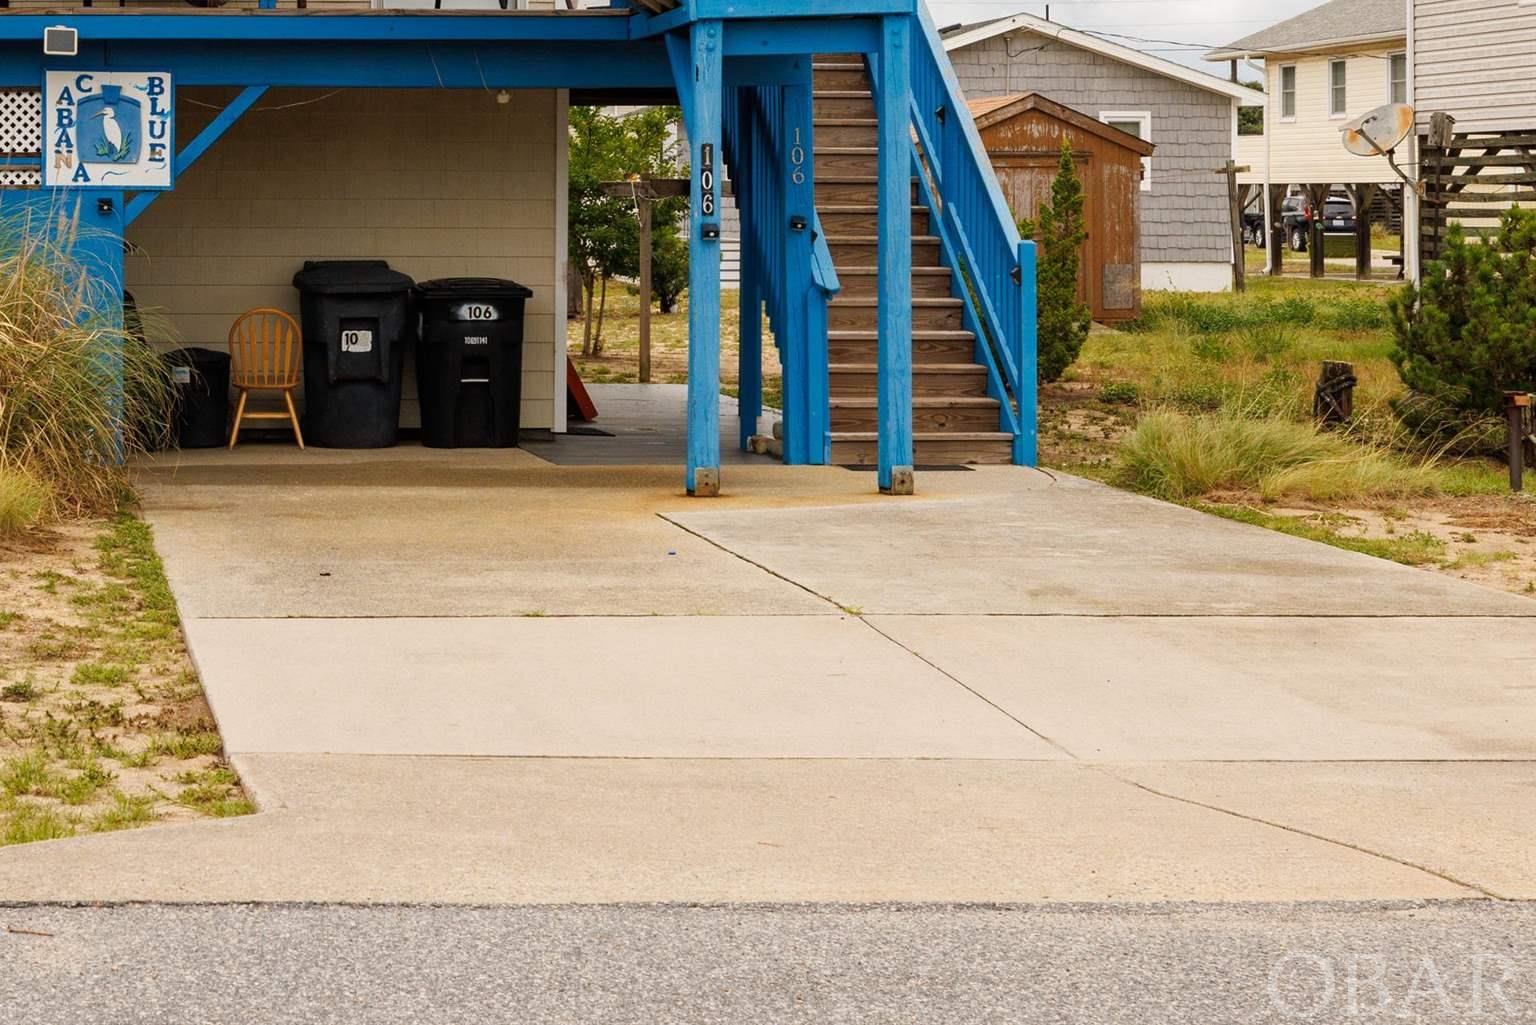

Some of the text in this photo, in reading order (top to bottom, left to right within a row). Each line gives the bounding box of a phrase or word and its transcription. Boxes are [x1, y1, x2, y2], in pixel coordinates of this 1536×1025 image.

[55, 74, 94, 183] CABANA
[147, 76, 167, 163] BLUE
[701, 145, 714, 214] 106
[791, 128, 805, 185] 106
[344, 332, 359, 345] 10
[467, 306, 492, 319] 106
